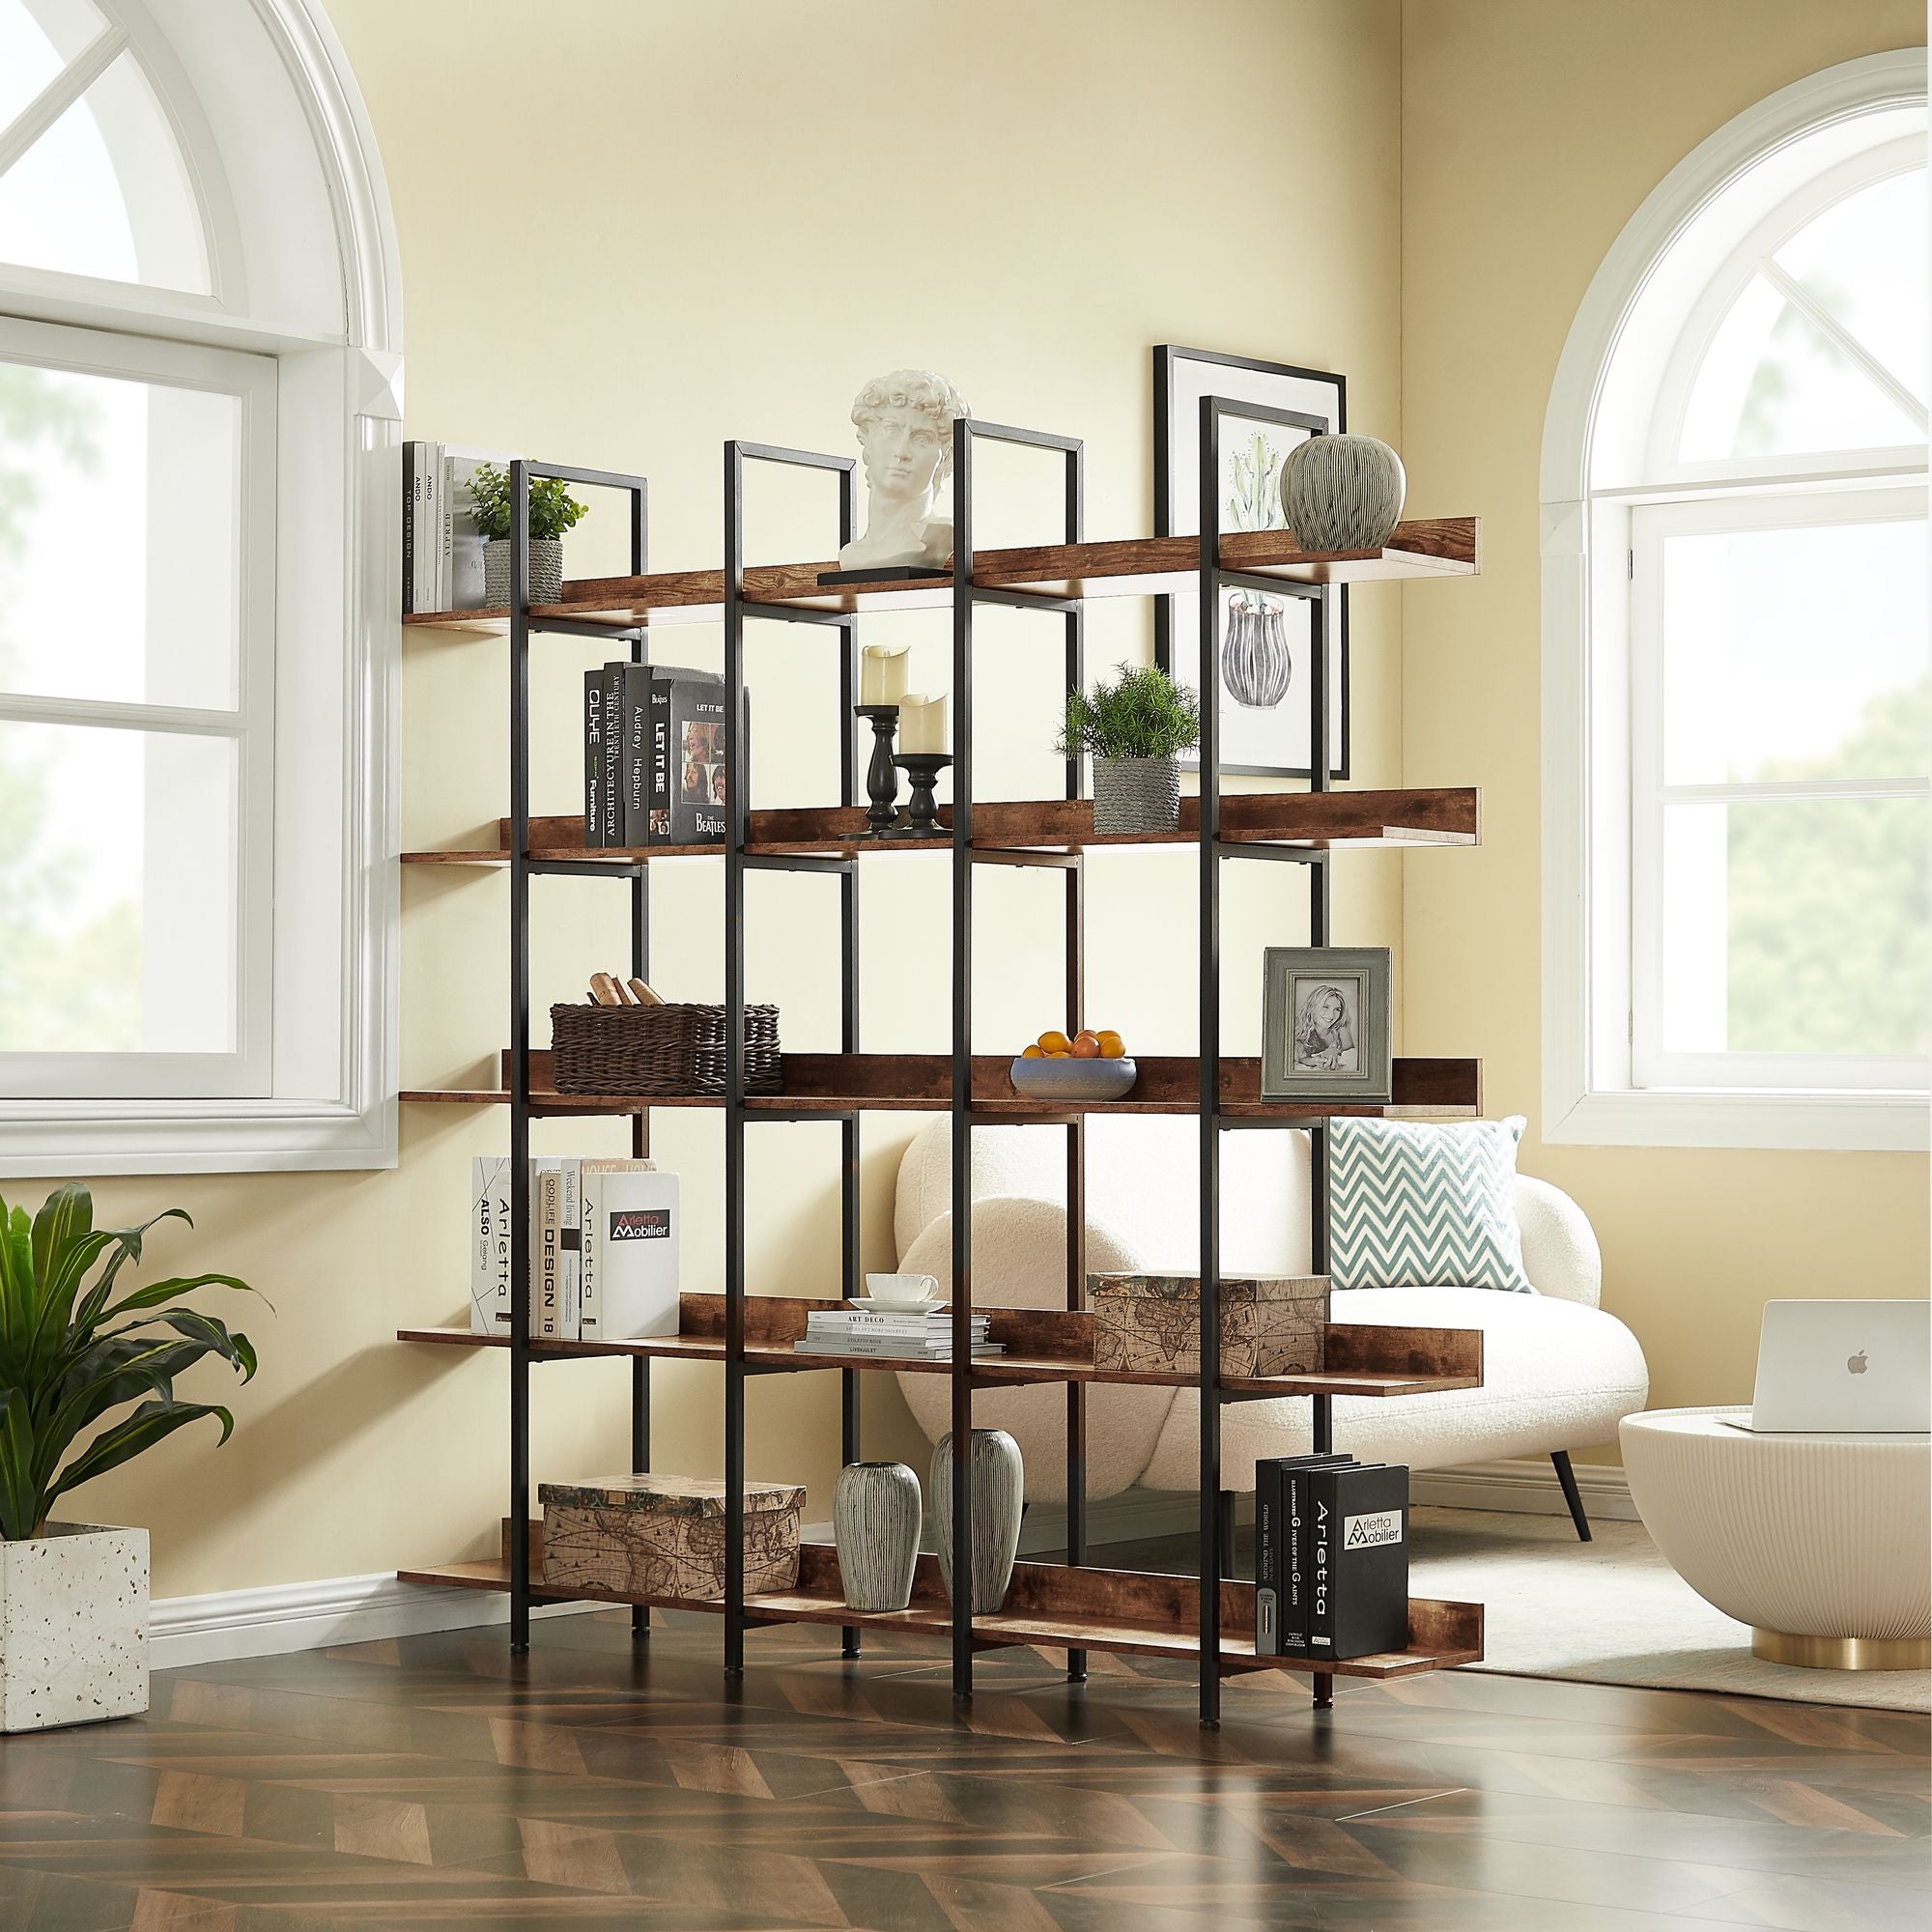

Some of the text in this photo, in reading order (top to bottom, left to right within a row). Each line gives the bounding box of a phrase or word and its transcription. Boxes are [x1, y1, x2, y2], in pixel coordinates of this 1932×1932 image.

[696, 703, 708, 712] LET
[607, 721, 614, 735] IN
[632, 706, 643, 810] Audrey Hepburn
[655, 723, 666, 793] LET IT BE
[696, 812, 726, 837] BEATLES
[564, 1170, 575, 1226] Weekend living
[480, 1200, 490, 1236] ALSO
[612, 1224, 668, 1237] Mobilier
[497, 1198, 511, 1296] Arletta
[584, 1199, 594, 1298] Arletta
[544, 1229, 554, 1333] DESIGN 18
[1347, 1528, 1400, 1546] Mobilier
[1352, 1516, 1392, 1532] Arletta
[1293, 1547, 1298, 1557] OF
[1317, 1500, 1329, 1615] Arletta
